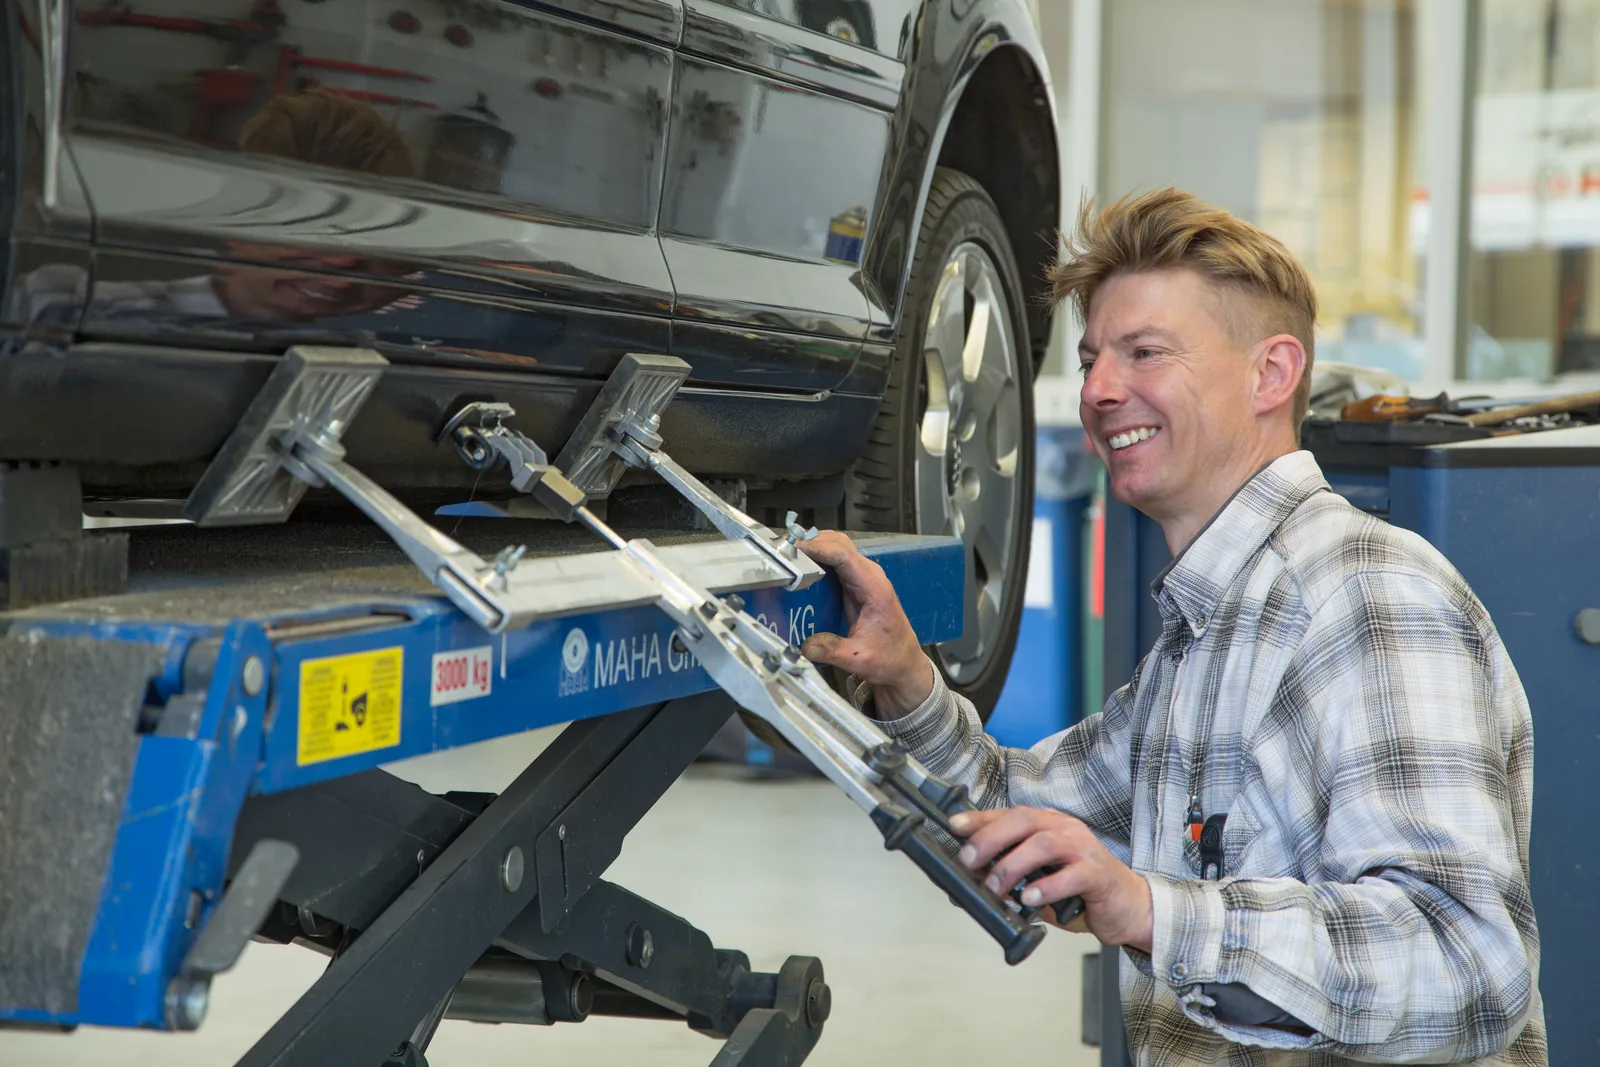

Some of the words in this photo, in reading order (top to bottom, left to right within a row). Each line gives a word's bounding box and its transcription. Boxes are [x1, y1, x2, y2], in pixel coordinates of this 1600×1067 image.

[435, 656, 468, 693] 3000
[473, 653, 489, 692] kg
[594, 632, 662, 689] MAHA
[789, 604, 815, 646] KG
